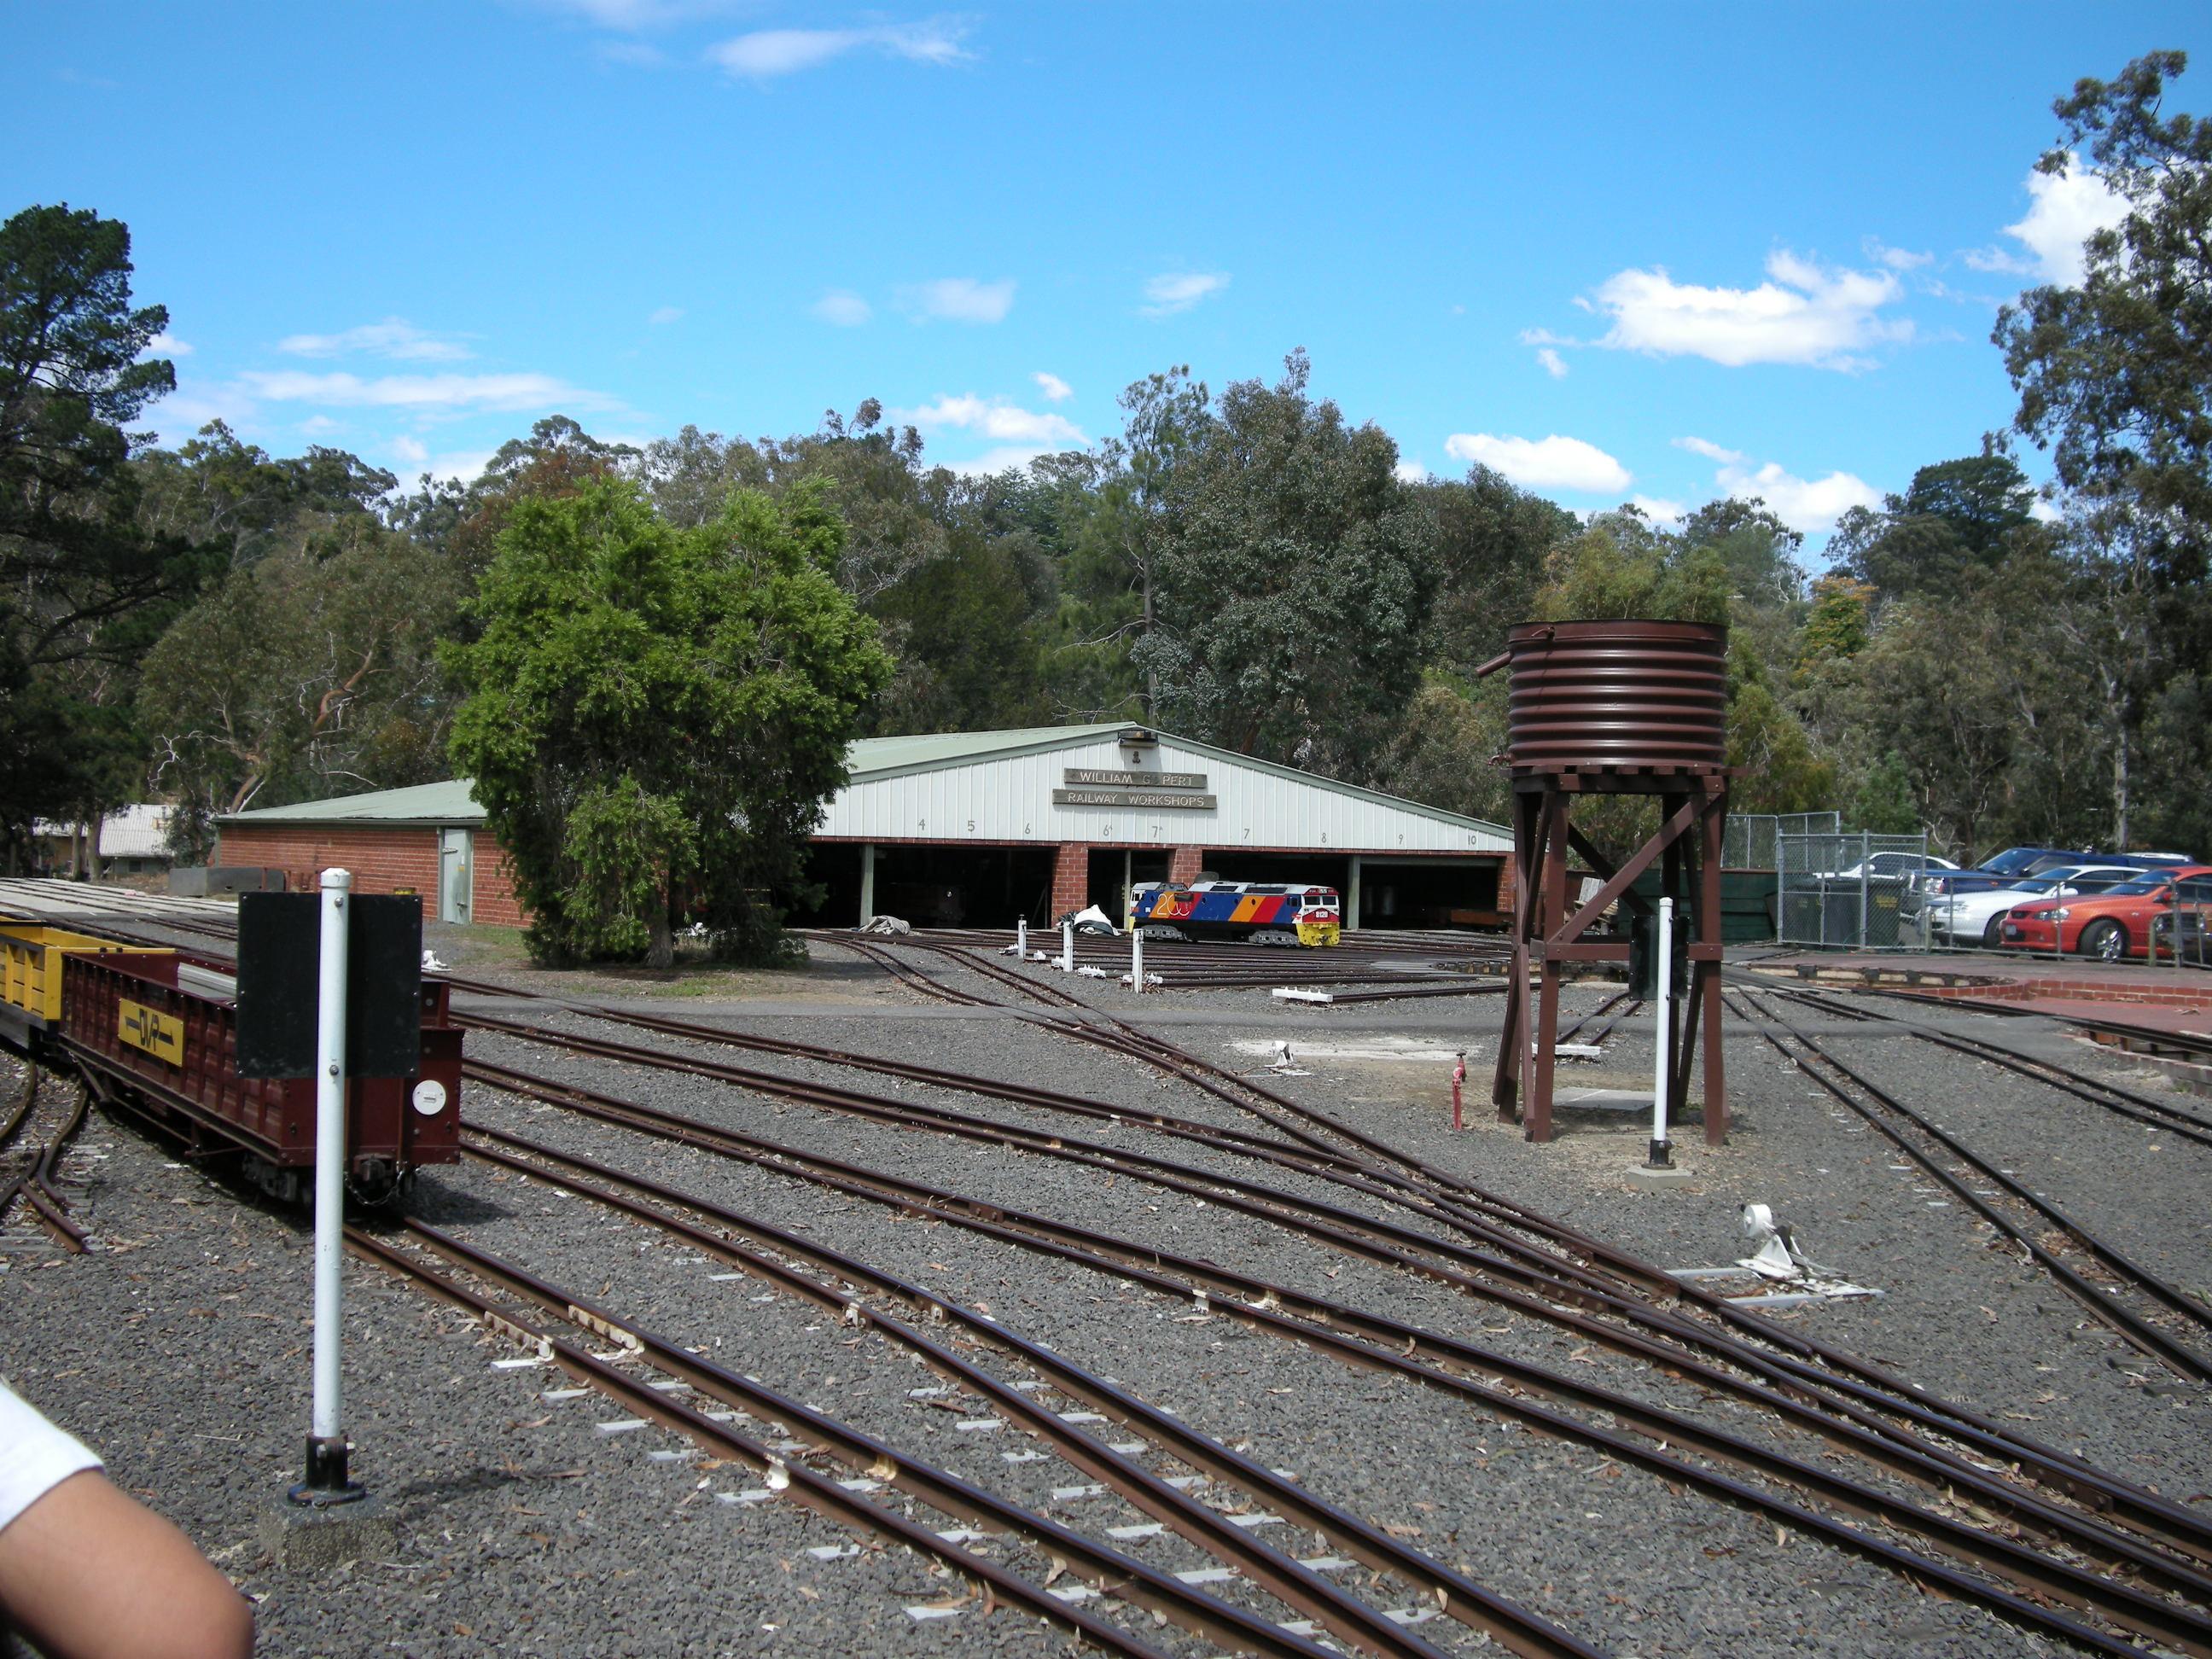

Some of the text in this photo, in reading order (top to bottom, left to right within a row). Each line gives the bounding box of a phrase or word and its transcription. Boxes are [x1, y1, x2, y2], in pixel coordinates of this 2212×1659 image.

[1080, 771, 1132, 783] WILLIAM
[1162, 774, 1195, 786] PERT
[1068, 792, 1204, 806] RAILWAY WORKSHOPS
[918, 819, 925, 830] 4
[968, 820, 975, 832] 5
[1024, 823, 1031, 834] 6
[1243, 829, 1250, 840] 7
[1321, 833, 1327, 843] 8
[1399, 834, 1404, 845] 9
[1468, 835, 1477, 845] 10
